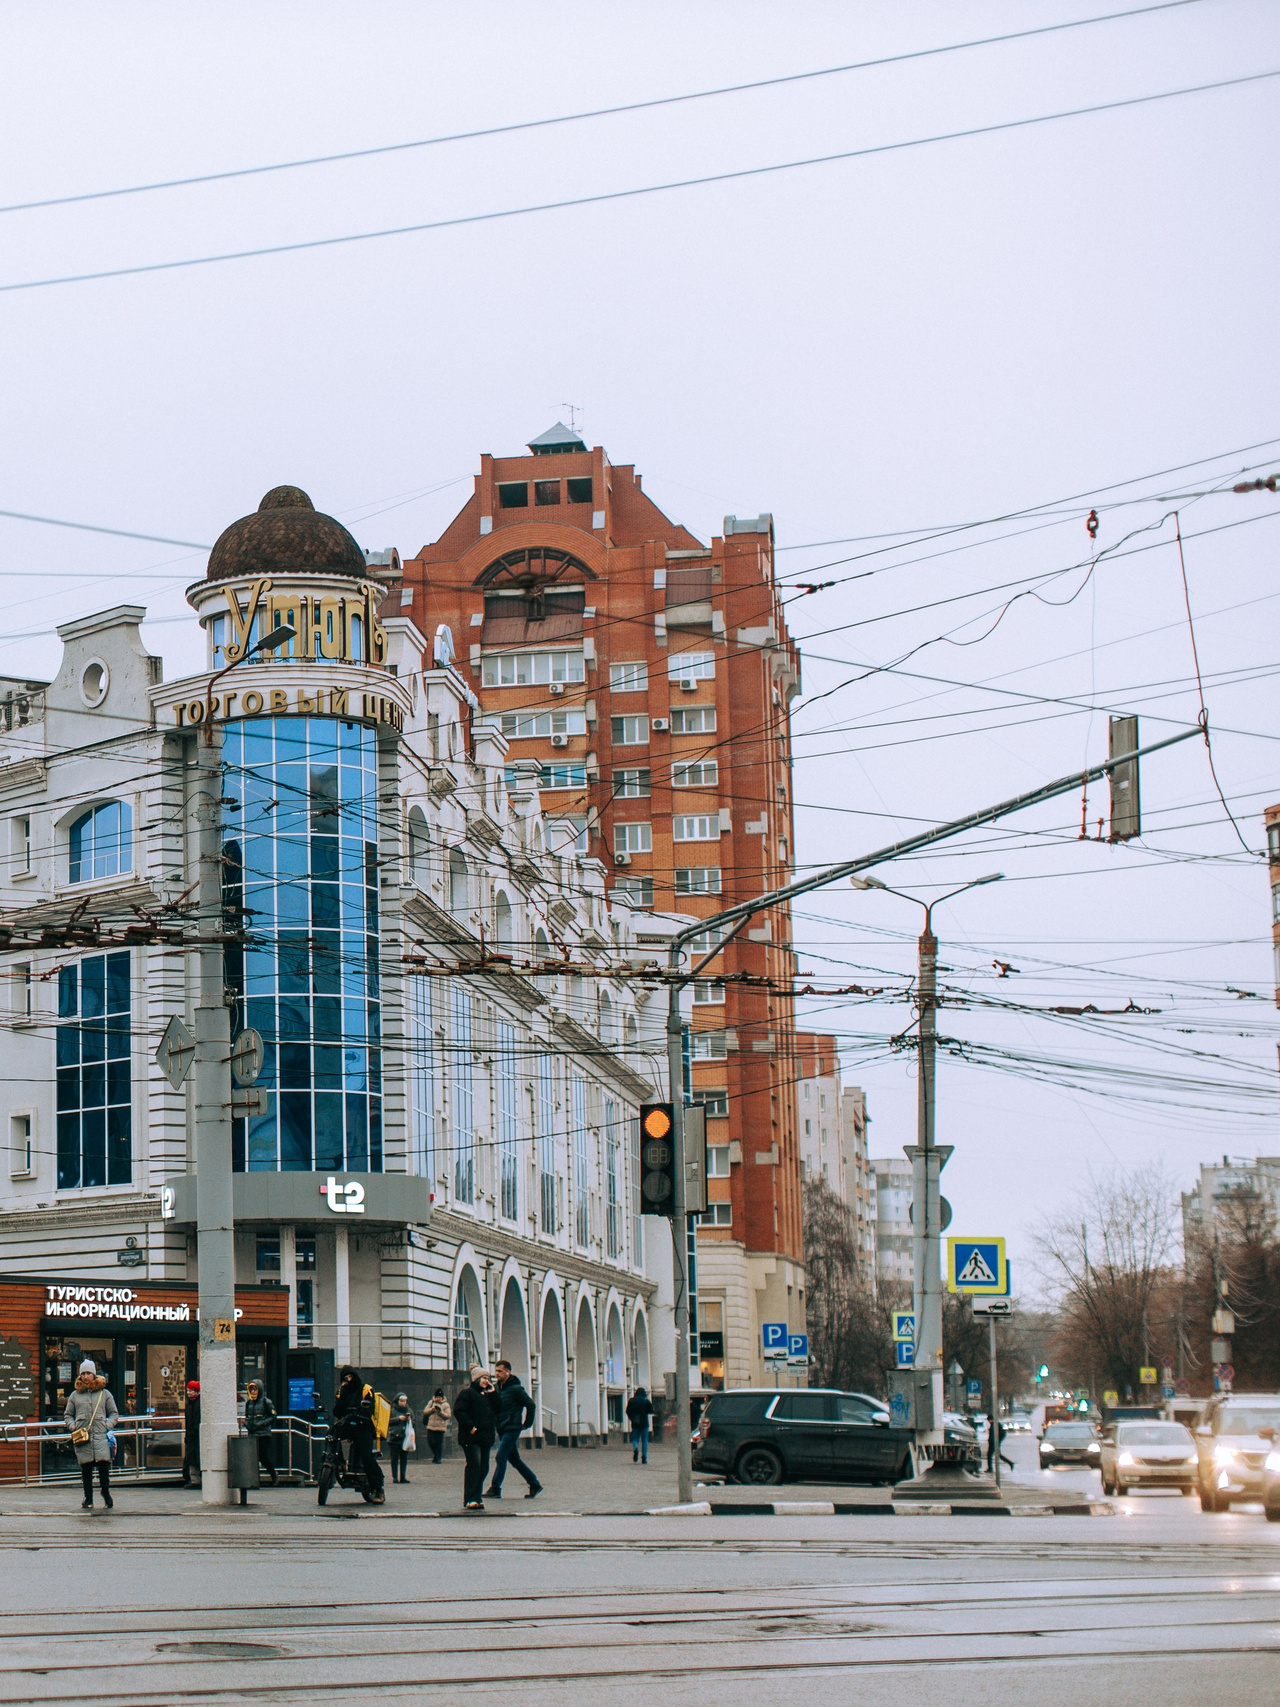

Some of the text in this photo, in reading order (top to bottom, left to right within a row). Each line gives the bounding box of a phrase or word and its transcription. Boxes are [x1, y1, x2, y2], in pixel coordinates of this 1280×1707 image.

[173, 686, 405, 733] ТОРГОВЫЙ ЦЕНТ
[320, 1176, 365, 1213] t2
[46, 1286, 138, 1302] ТУРИСТСКО-
[45, 1302, 190, 1321] ИНФОРМАЦИОННЫЙ
[218, 1323, 231, 1334] 74
[768, 1326, 782, 1345] P
[791, 1337, 803, 1354] P
[903, 1344, 915, 1361] P
